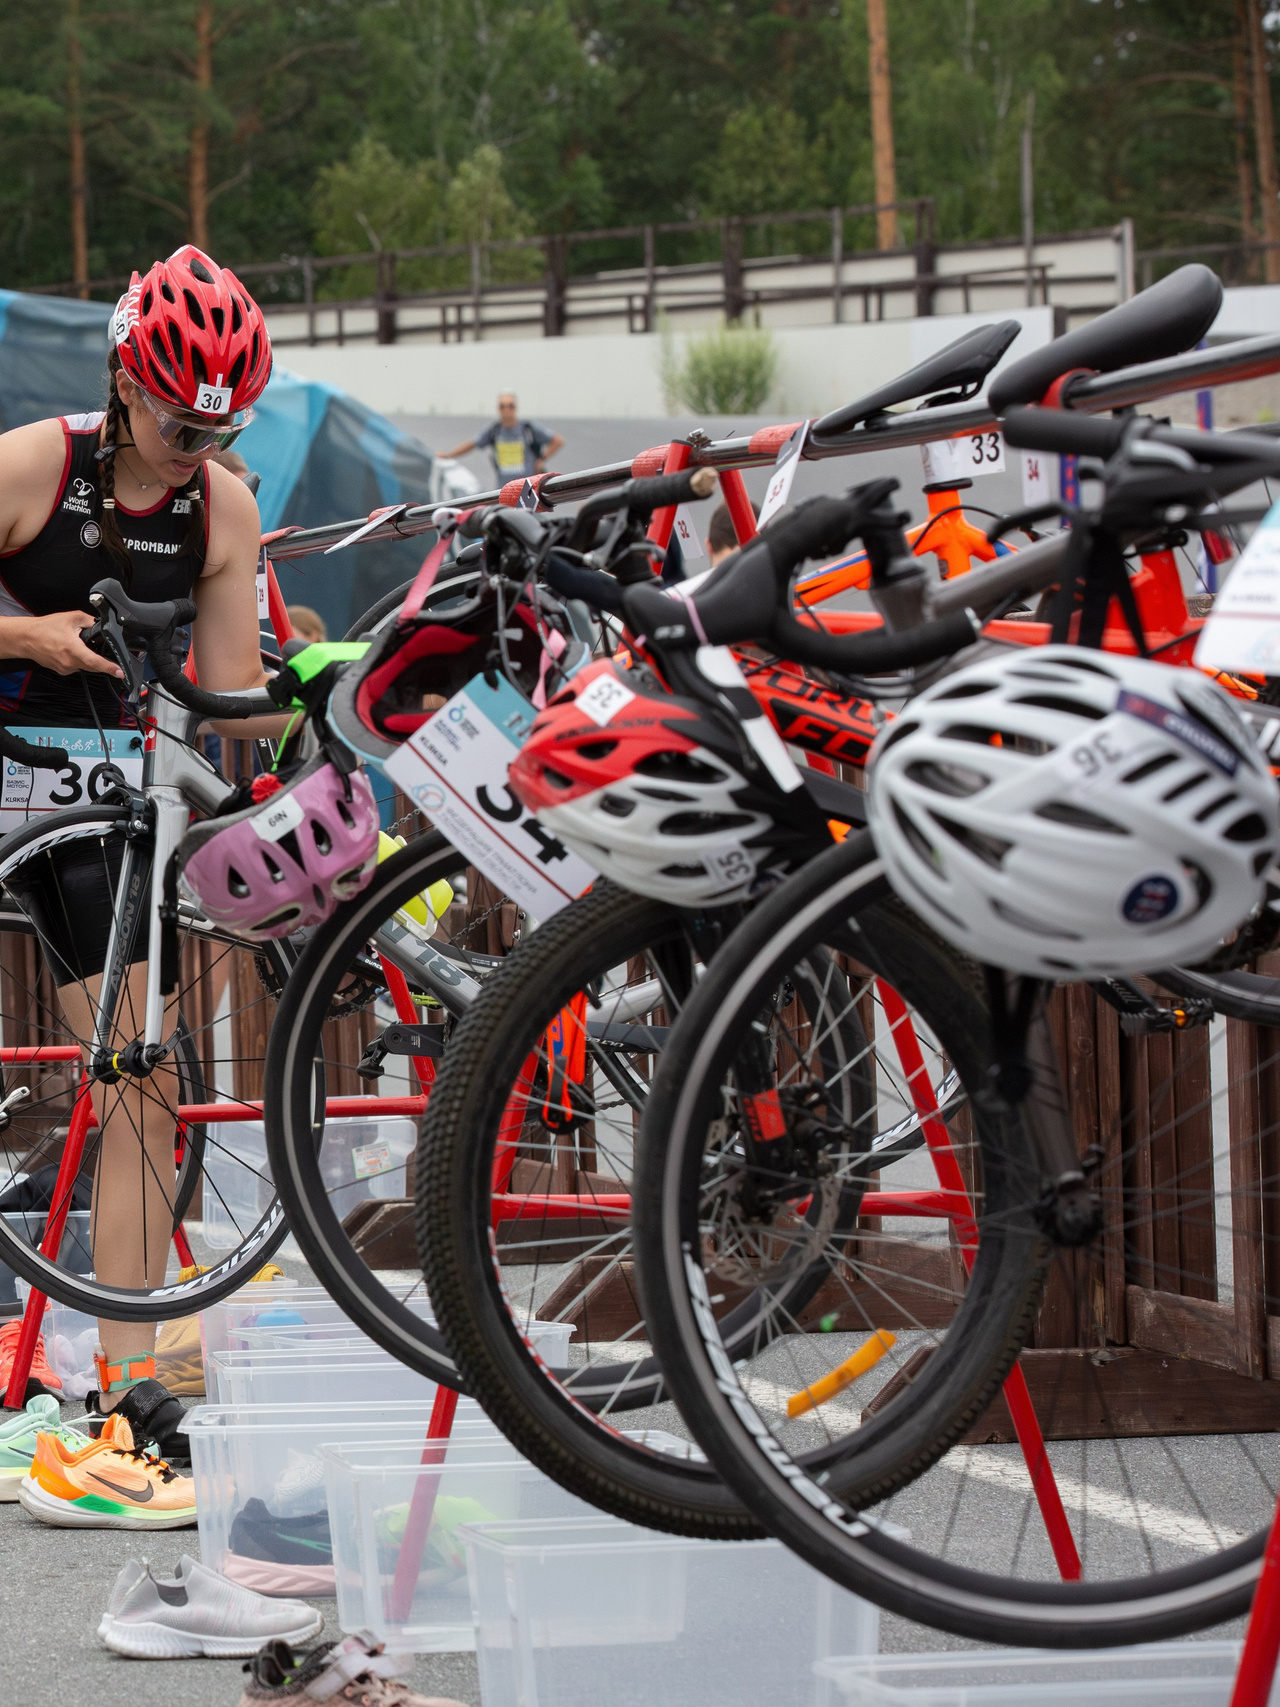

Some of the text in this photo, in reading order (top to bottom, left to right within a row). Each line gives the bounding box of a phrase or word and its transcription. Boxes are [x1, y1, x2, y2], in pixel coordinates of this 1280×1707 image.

[200, 392, 222, 411] 30
[971, 432, 1000, 464] 33
[62, 501, 91, 515] Triathlon
[68, 495, 89, 507] World
[1072, 732, 1122, 778] 36
[49, 762, 126, 806] 30
[717, 850, 750, 880] 35
[110, 873, 141, 994] ARGON 18
